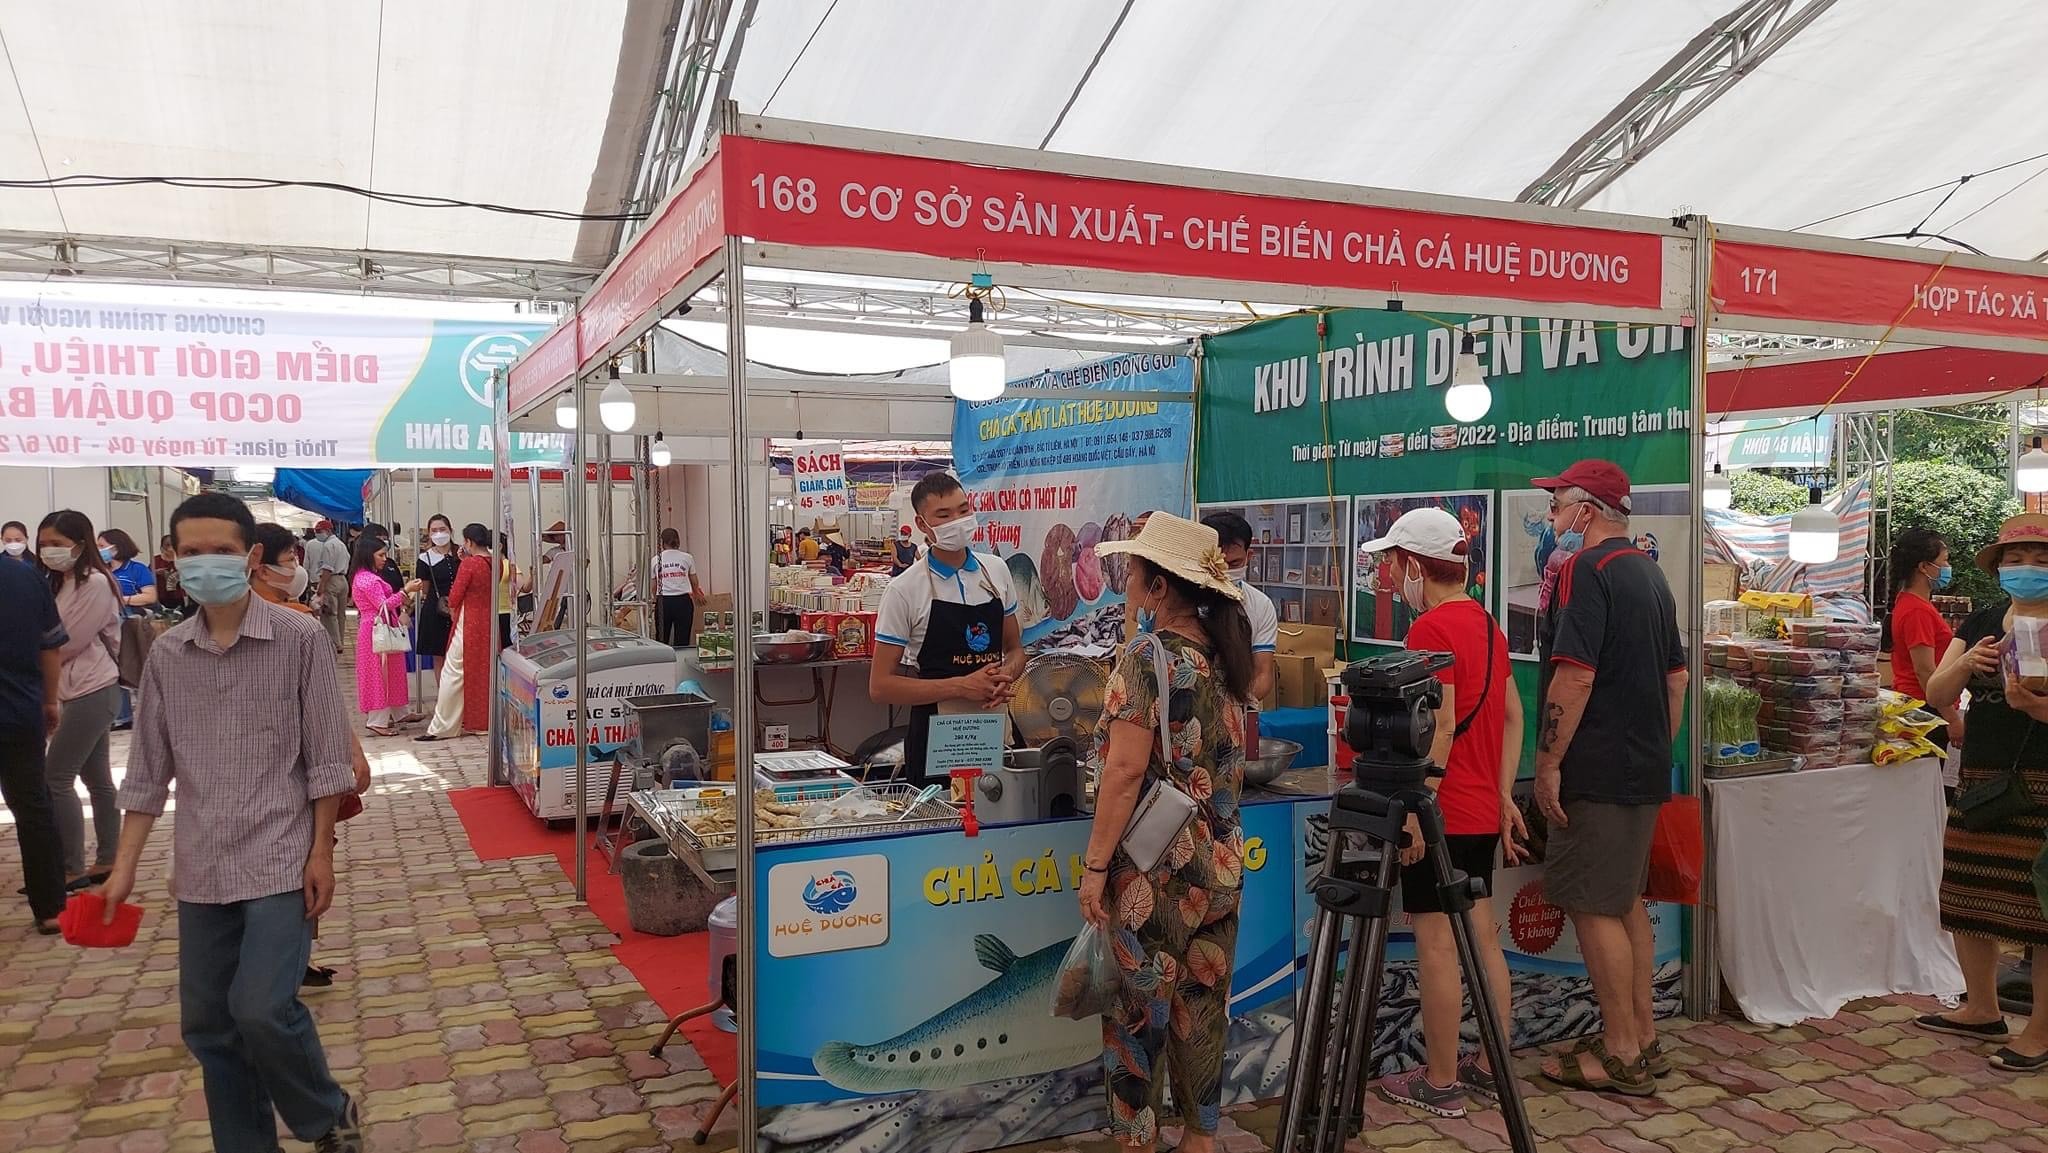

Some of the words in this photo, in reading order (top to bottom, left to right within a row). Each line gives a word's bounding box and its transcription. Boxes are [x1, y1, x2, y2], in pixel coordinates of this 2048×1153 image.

[750, 172, 818, 215] 168
[840, 182, 903, 222] CƠ
[913, 184, 972, 229] SỞ
[983, 192, 1058, 238] SẢN
[1068, 203, 1175, 248] XUẤT-
[1182, 215, 1251, 256] CHẾ
[1260, 220, 1333, 261] BIẾN
[1343, 228, 1406, 267] CHẢ
[1415, 233, 1456, 272] CÁ
[1464, 242, 1521, 283] HUỆ
[1529, 247, 1629, 284] DƯƠNG
[1740, 265, 1779, 296] 171
[1913, 283, 1960, 317] HỢP
[1965, 284, 2005, 317] TÁC
[2010, 289, 2038, 321] XÃ
[1254, 355, 1308, 414] KHU
[1317, 332, 1414, 402] TRÌNH
[1292, 445, 1310, 462] Thời
[1338, 439, 1350, 457] Từ
[1353, 437, 1378, 458] ngày
[1407, 428, 1428, 450] đến
[1456, 424, 1497, 447] /2022
[1508, 421, 1533, 446] Địa
[1536, 413, 1579, 440] điểm:
[1583, 414, 1627, 437] Trung
[1632, 409, 1662, 432] tâm
[797, 450, 842, 473] SÁCH
[801, 496, 813, 508] 45
[822, 494, 846, 507] 50%
[1019, 483, 1031, 510] CÁ
[601, 682, 614, 698] CÁ
[546, 722, 576, 747] CHẢ
[922, 849, 1004, 906] CHẢ
[1011, 848, 1062, 896] CÁ
[774, 918, 813, 937] HUỆ
[820, 913, 883, 931] DƯƠNG
[1518, 910, 1538, 926] thực
[1541, 908, 1562, 923] hiện
[1518, 930, 1525, 941] 5
[1527, 925, 1556, 940] không
